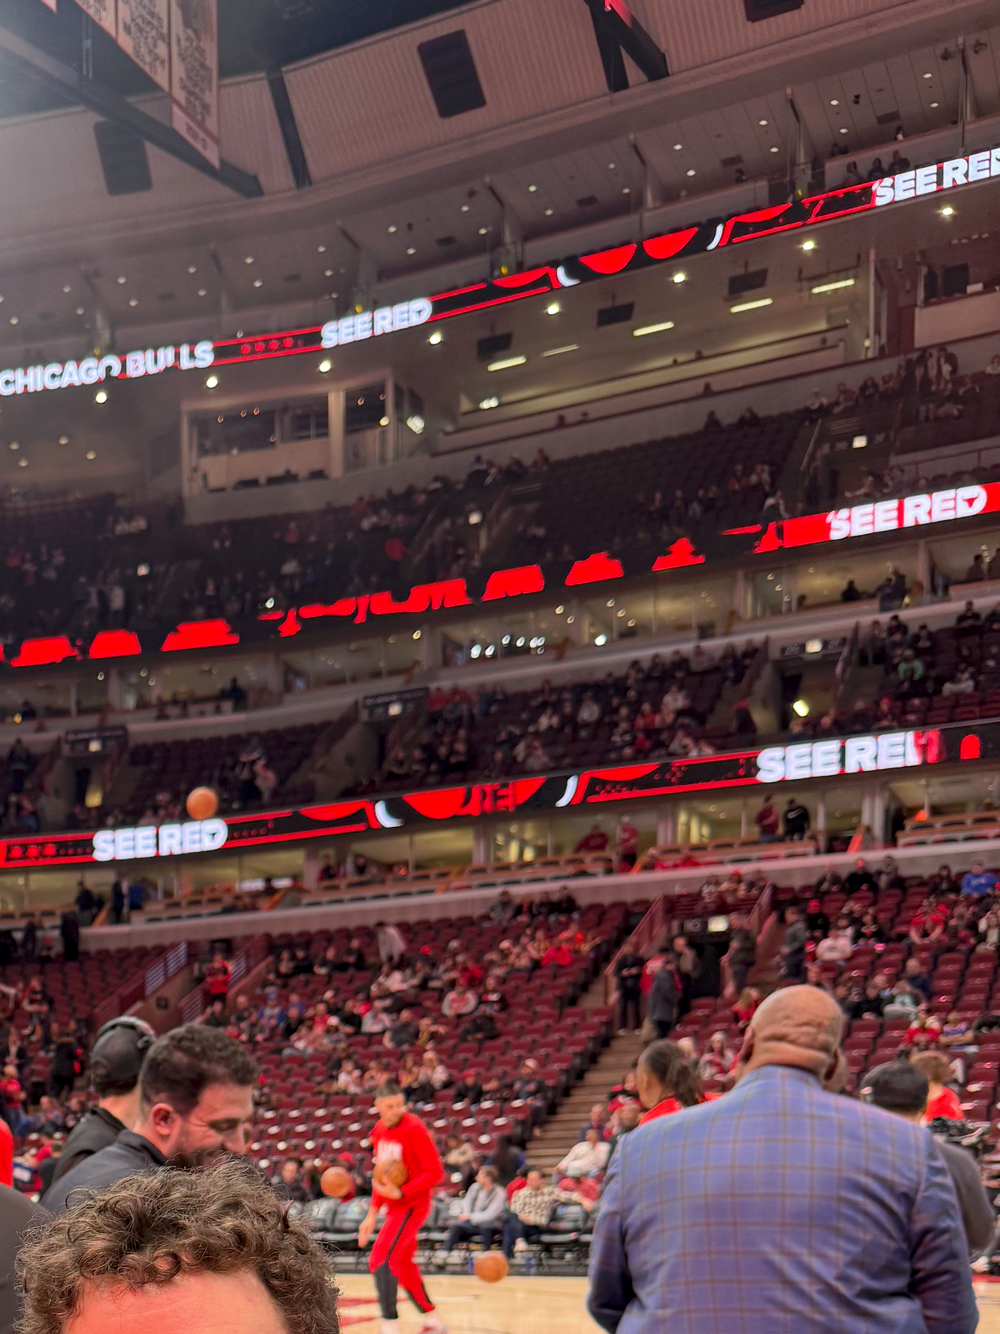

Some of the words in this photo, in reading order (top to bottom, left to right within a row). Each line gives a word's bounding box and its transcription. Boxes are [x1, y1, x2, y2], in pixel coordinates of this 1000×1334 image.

[872, 164, 938, 206] SEE
[321, 311, 373, 349] SEE
[374, 298, 433, 336] RED
[827, 499, 899, 540] SEE
[903, 485, 988, 527] RED
[756, 739, 842, 783] SEE
[92, 825, 157, 861] SEE
[159, 818, 229, 856] RED
